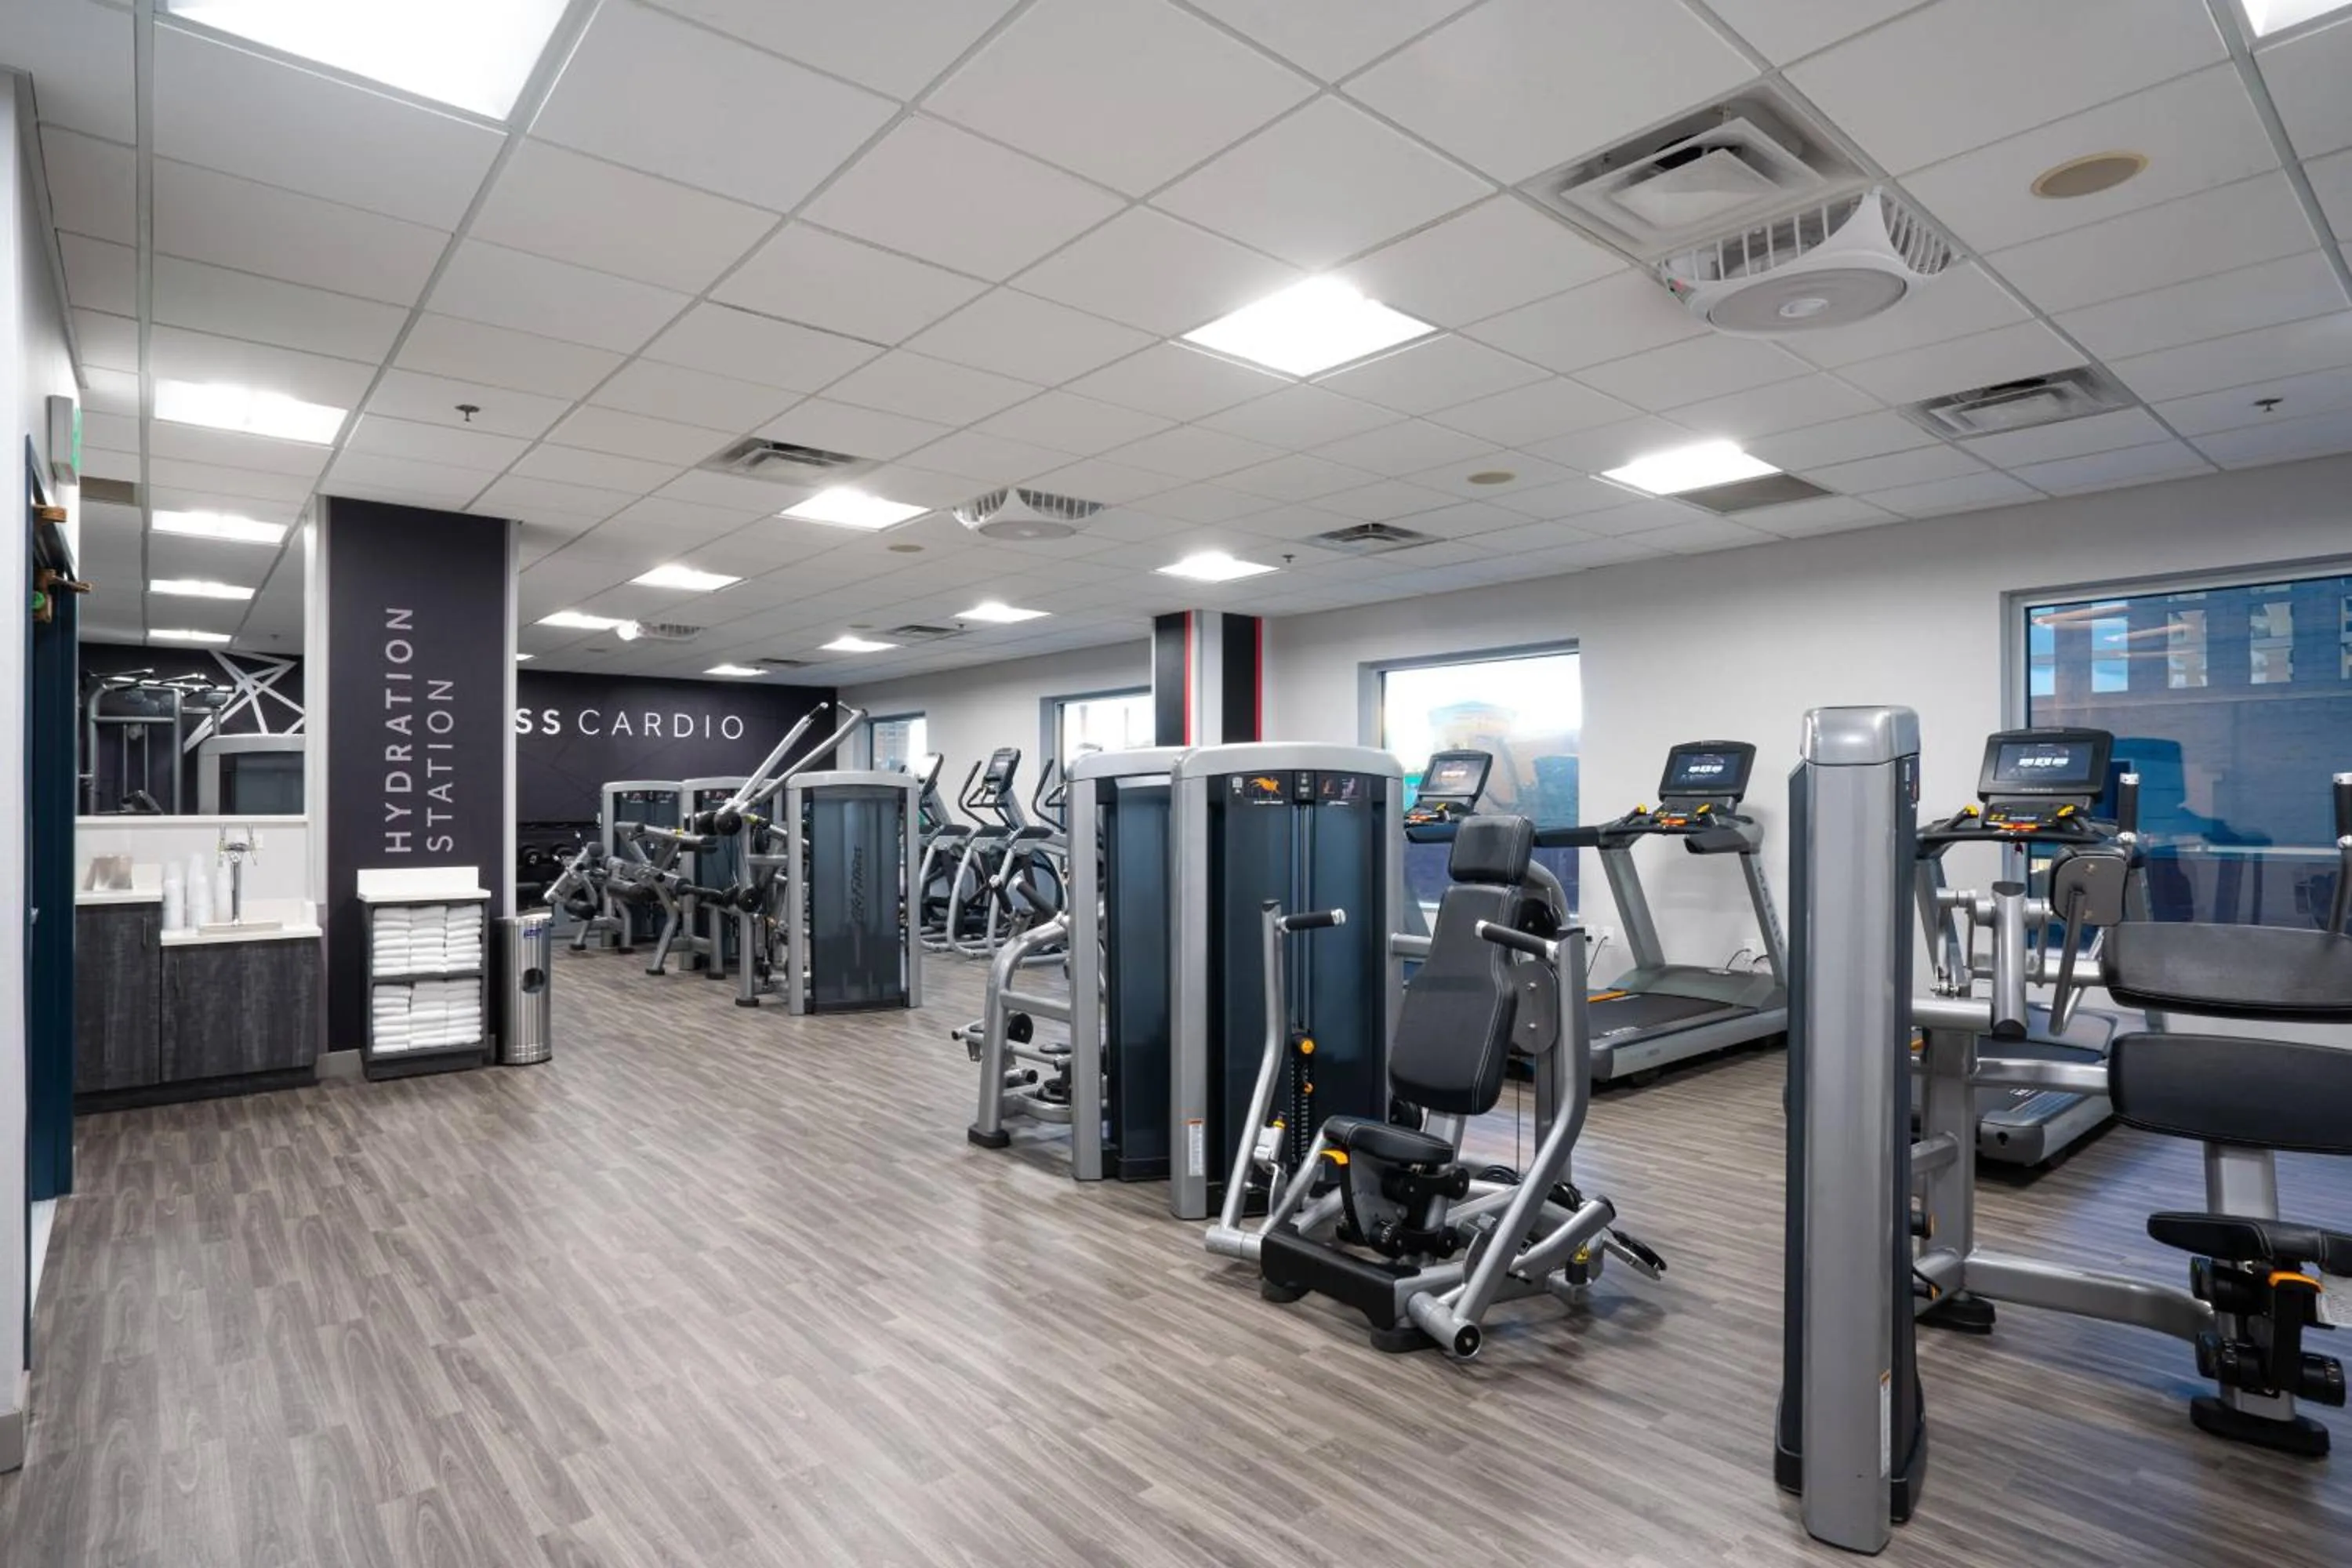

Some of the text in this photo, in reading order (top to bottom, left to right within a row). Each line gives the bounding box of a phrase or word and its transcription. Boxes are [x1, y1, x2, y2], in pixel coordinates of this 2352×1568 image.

[385, 608, 413, 852] HYDRATION
[426, 680, 454, 851] STATION
[578, 710, 744, 739] CARDIO
